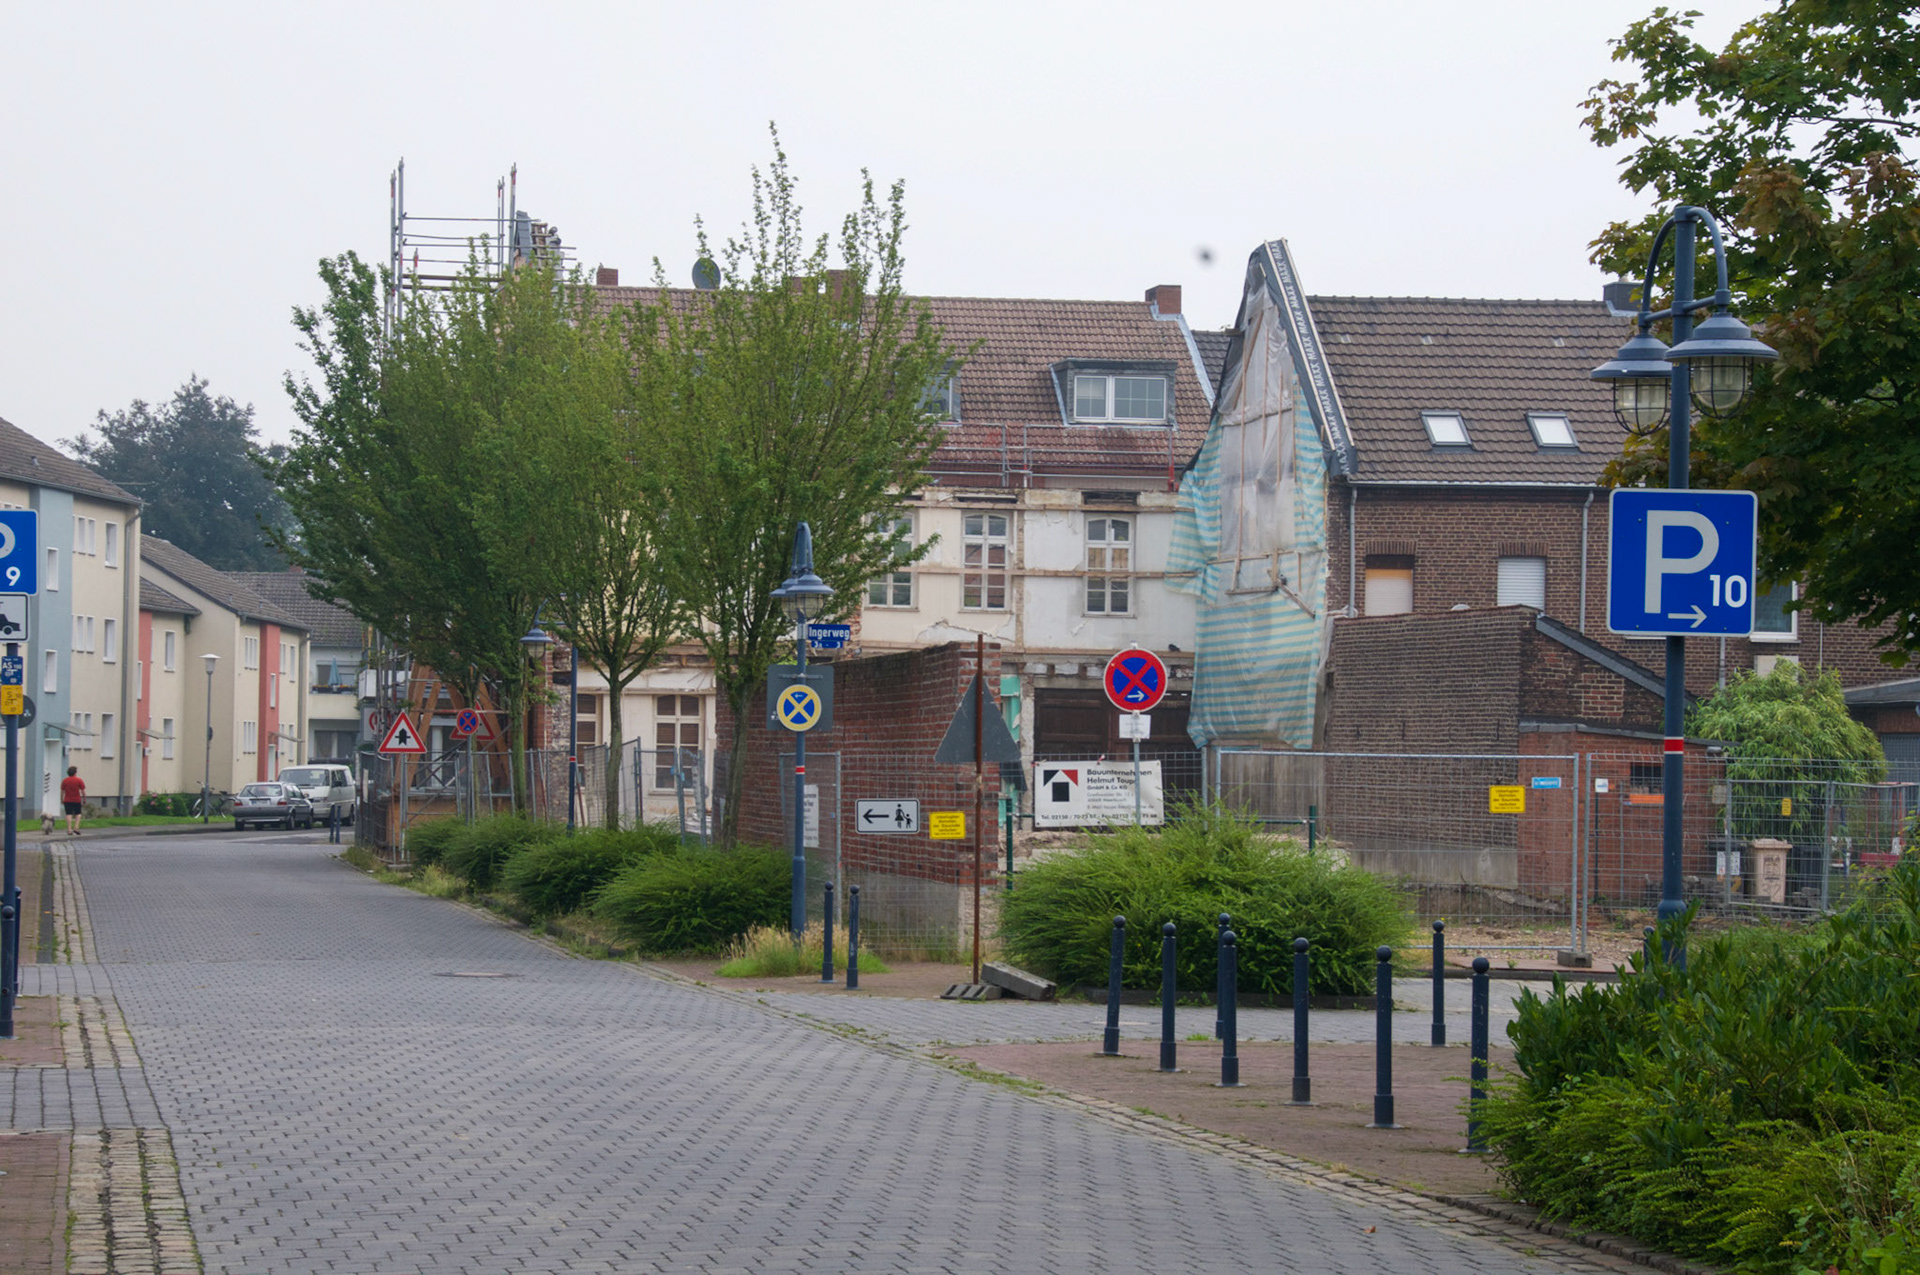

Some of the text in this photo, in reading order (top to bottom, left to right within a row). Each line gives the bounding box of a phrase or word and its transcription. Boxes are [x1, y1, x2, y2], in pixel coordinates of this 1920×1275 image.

[1277, 261, 1292, 283] MAXX
[1285, 285, 1300, 309] MAXX
[1294, 310, 1309, 335] MAXX
[1302, 336, 1317, 361] MAXX
[1310, 362, 1325, 387] MAXX
[1319, 389, 1334, 413] MAXX
[1327, 415, 1342, 440] MAXX
[1335, 441, 1350, 475] MAXX
[1644, 510, 1719, 613] P
[6, 566, 21, 586] 9
[1709, 574, 1747, 608] 10
[809, 626, 850, 640] Ingerweg
[1117, 777, 1137, 785] Toup
